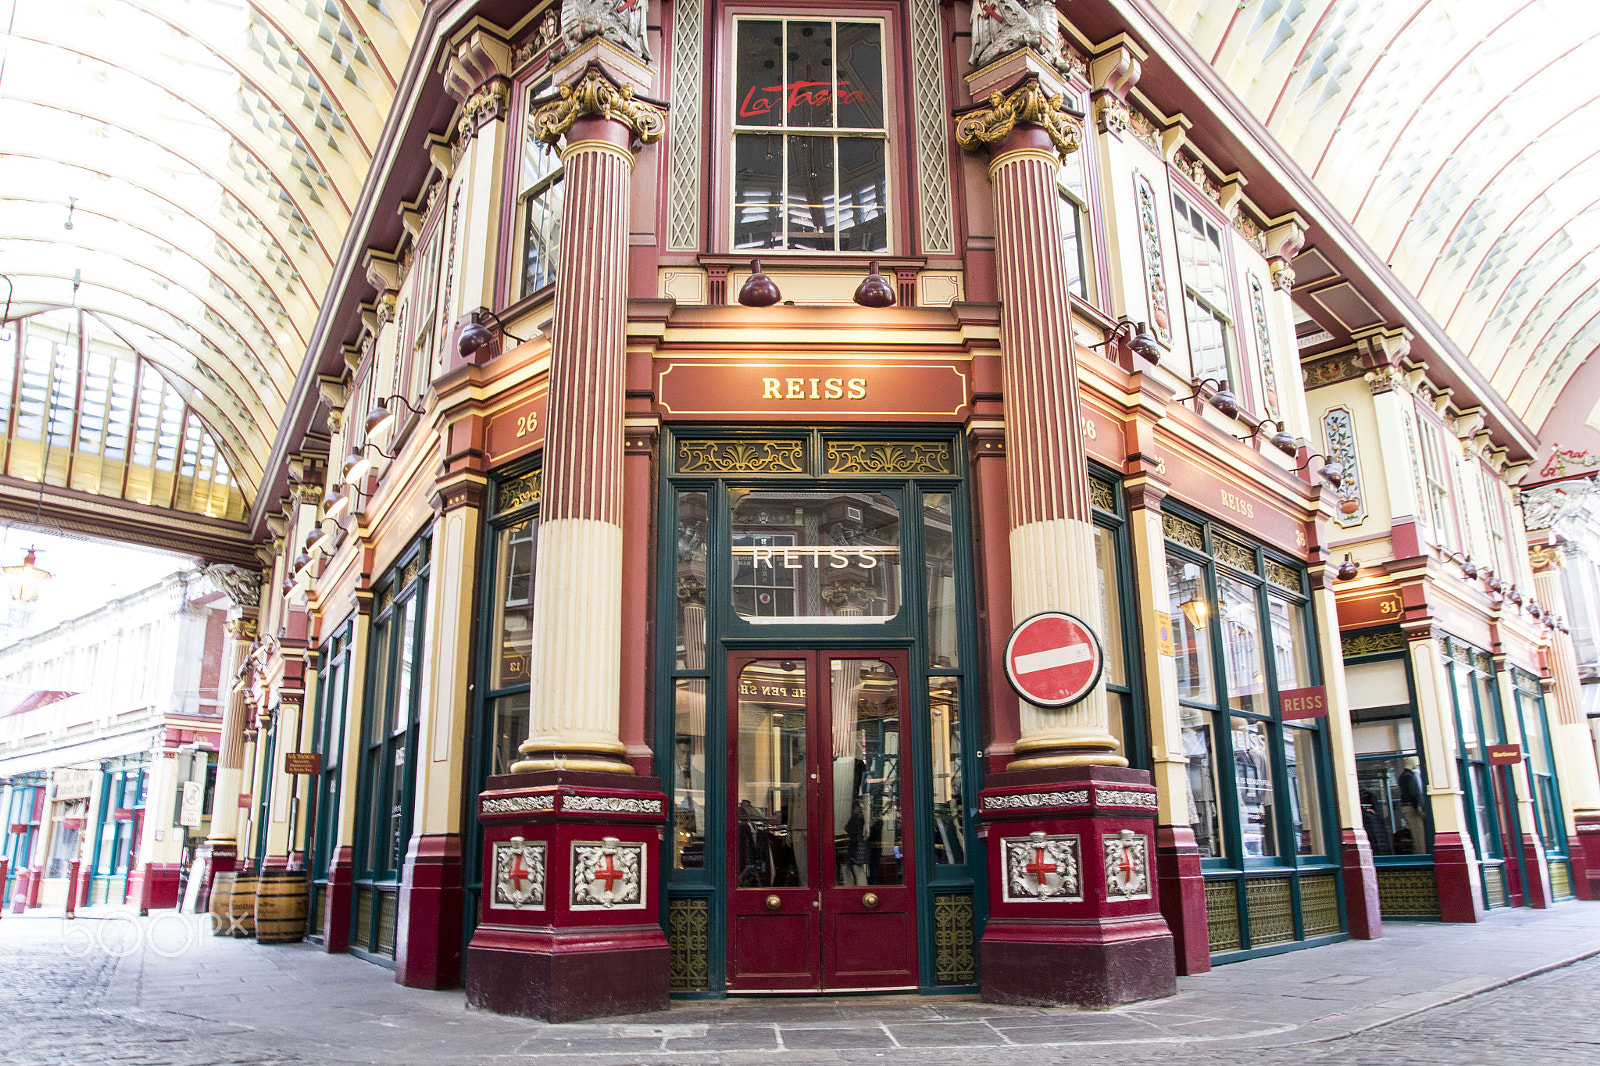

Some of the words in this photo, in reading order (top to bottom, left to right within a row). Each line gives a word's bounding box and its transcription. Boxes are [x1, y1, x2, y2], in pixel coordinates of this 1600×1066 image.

[740, 85, 782, 117] La
[761, 80, 879, 113] Tasca
[762, 378, 867, 400] REISS
[516, 411, 538, 438] 26
[1220, 489, 1254, 519] REISS
[753, 548, 877, 569] REISS
[1380, 600, 1398, 614] 31
[1284, 695, 1322, 712] REISS
